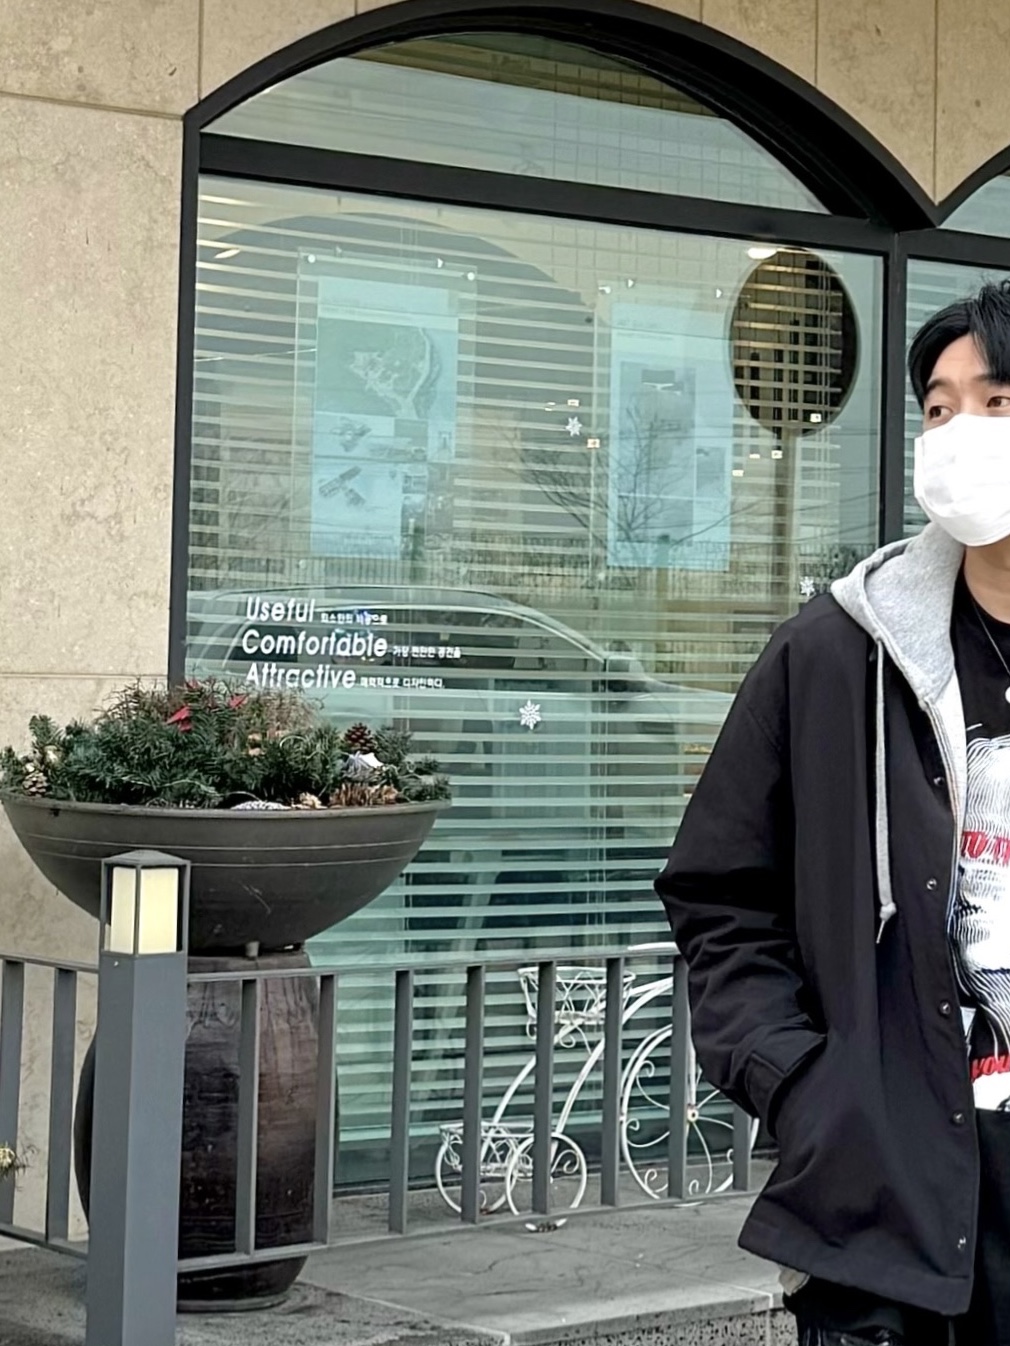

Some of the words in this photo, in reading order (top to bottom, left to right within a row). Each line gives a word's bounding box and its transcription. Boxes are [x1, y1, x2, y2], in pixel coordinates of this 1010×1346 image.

[245, 596, 315, 622] Useful
[242, 628, 388, 657] Comfortable
[246, 662, 356, 688] Attractive
